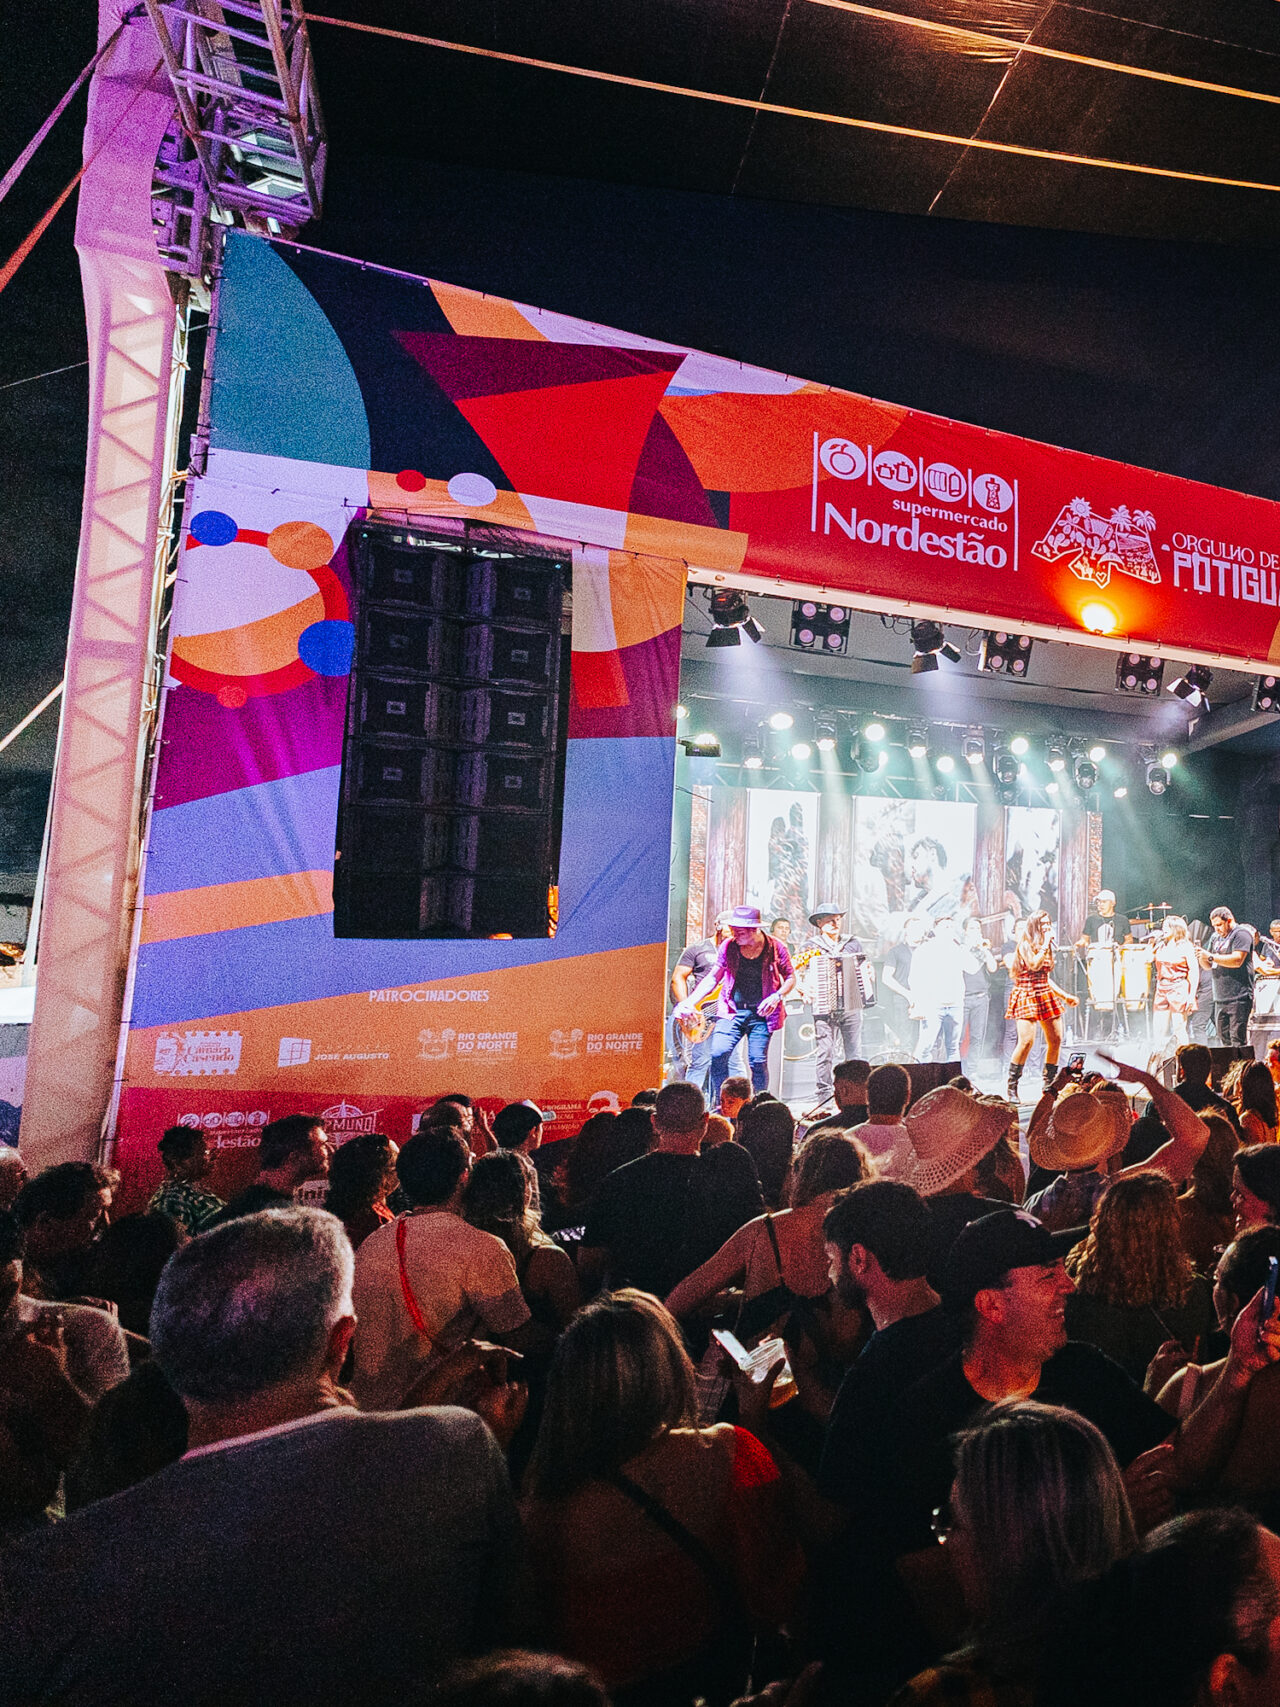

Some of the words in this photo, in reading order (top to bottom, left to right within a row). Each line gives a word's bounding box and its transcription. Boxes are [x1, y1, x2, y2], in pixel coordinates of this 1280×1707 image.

[892, 499, 1009, 533] supermercado
[824, 502, 1008, 568] Nordestão
[1172, 531, 1255, 564] ORGULHO
[1259, 551, 1280, 570] DE
[368, 989, 490, 1003] PATROCINADORES
[457, 1032, 475, 1041] RIO
[477, 1031, 518, 1040] GRANDE
[586, 1033, 604, 1041] RIO
[605, 1032, 643, 1041] GRANDE
[456, 1041, 475, 1050] DO
[477, 1040, 518, 1050] NORTE
[586, 1042, 603, 1051] DO
[605, 1041, 643, 1050] NORTE
[343, 1052, 390, 1060] AUGUSTO
